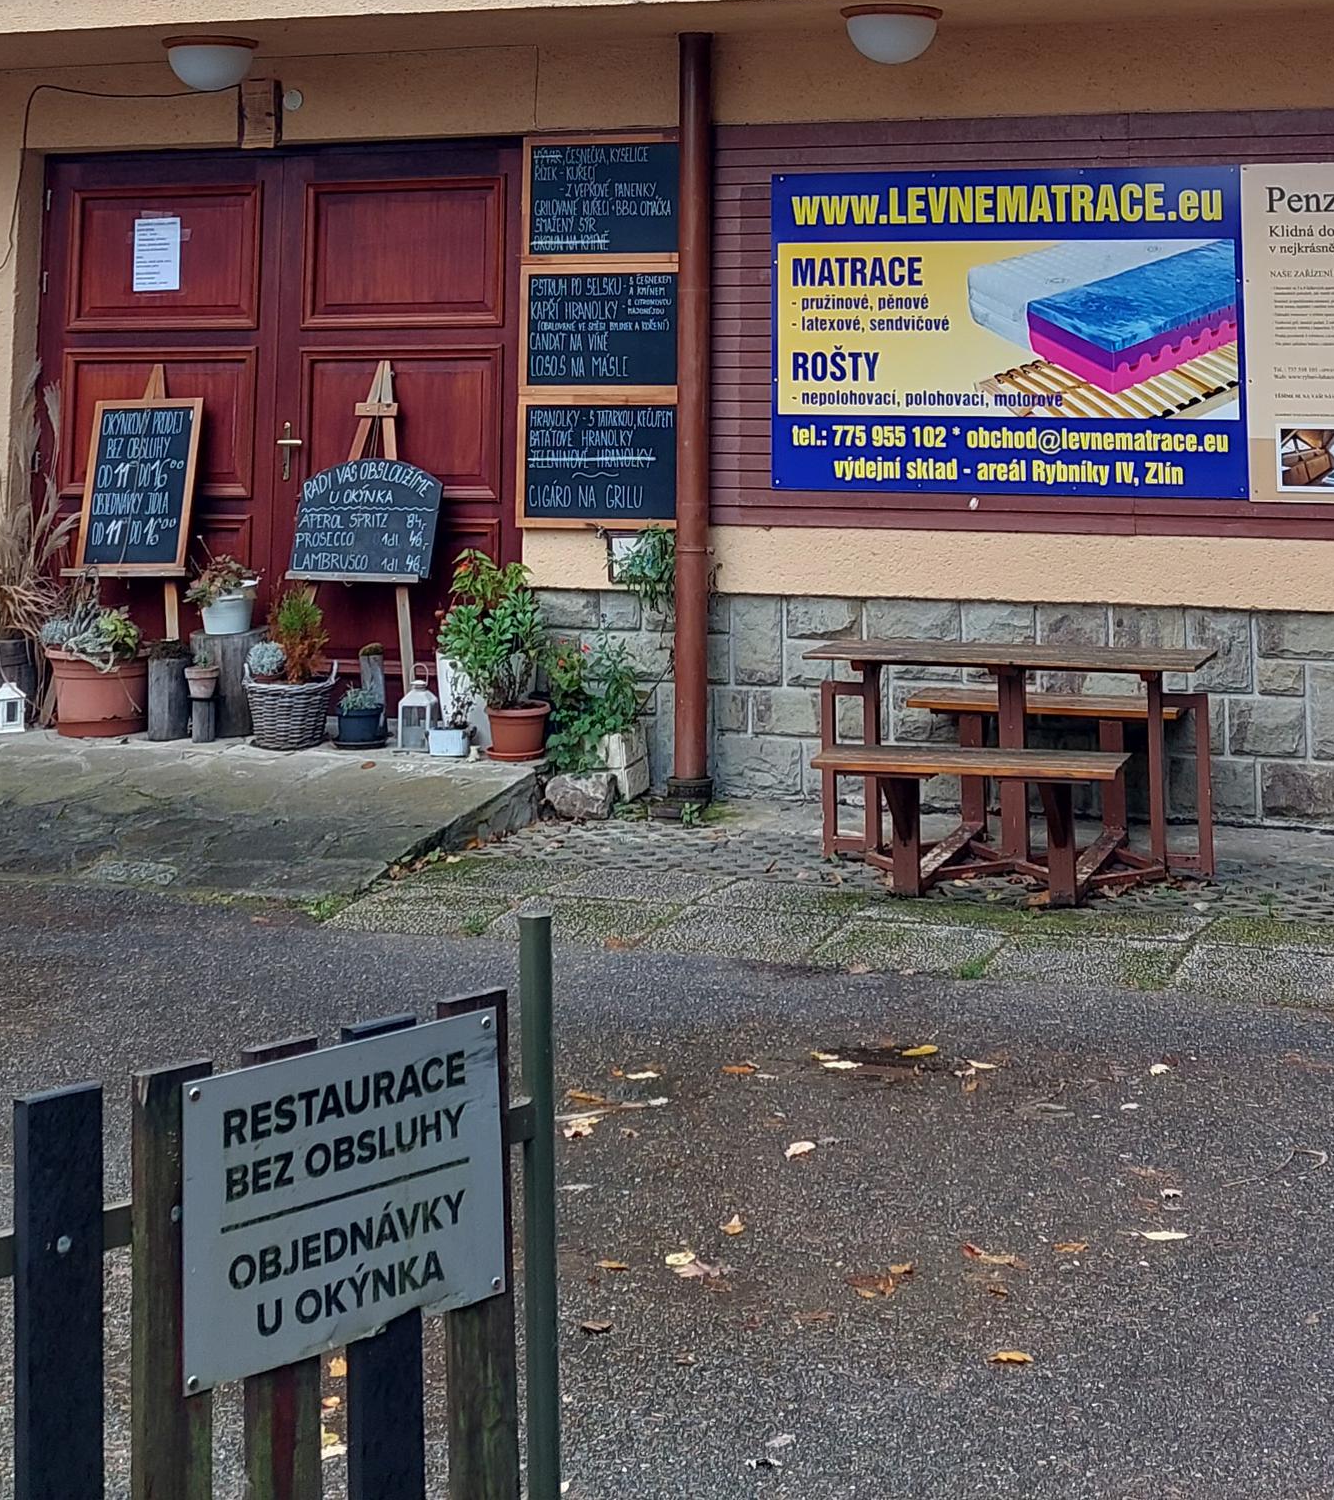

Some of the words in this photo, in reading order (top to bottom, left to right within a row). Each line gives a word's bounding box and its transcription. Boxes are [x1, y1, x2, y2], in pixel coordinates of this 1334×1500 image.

[792, 183, 1223, 226] www.LEVNEMATRACE.eu
[1269, 224, 1314, 238] Klidná
[1269, 246, 1275, 254] v
[792, 256, 923, 287] MATRACE
[531, 278, 567, 296] PSTRUH
[571, 277, 582, 296] PO
[586, 277, 622, 296] SELSKU
[801, 293, 874, 312] pružinové,
[877, 294, 929, 311] pěnové
[801, 315, 865, 332] latexové,
[869, 316, 950, 332] sendvičové
[570, 333, 583, 351] NA
[531, 355, 566, 377] LOSOS
[571, 356, 585, 377] NA
[791, 346, 880, 382] ROŠTY
[801, 390, 901, 409] nepolohovací,
[905, 391, 990, 409] polohovací,
[993, 392, 1063, 409] motorové
[151, 411, 183, 435] PRODEJ
[106, 438, 124, 459] BEZ
[127, 436, 172, 459] OBSLUHY
[582, 429, 634, 447] HRANOLKY
[792, 426, 827, 447] tel.:
[832, 426, 866, 447] 775
[871, 427, 906, 447] 955
[911, 427, 946, 448] 102
[967, 428, 1228, 454] obchod@levnematrace.eu
[303, 472, 332, 502] RÁDI
[335, 461, 358, 484] VÁS
[360, 462, 434, 497] OBSLOUŽÍME
[834, 459, 901, 482] výdejní
[906, 459, 957, 480] sklad
[977, 460, 1025, 482] areál
[1032, 460, 1109, 485] Rybníky
[1144, 462, 1184, 485] Zlín
[329, 491, 340, 504] U
[343, 484, 393, 504] OKÝNKA
[578, 485, 596, 508] NA
[606, 484, 643, 509] GRILU
[349, 513, 389, 528] SPRITZ
[295, 532, 354, 548] PROSECCO
[293, 553, 368, 570] LAMBRUSCO
[223, 1050, 465, 1149] RESTAURACE
[226, 1151, 294, 1203] BEZ
[305, 1102, 466, 1178] OBSLUHY
[228, 1190, 465, 1290] OBJEDNÁVKY
[257, 1298, 282, 1336] U
[295, 1251, 445, 1324] OKÝNKA
